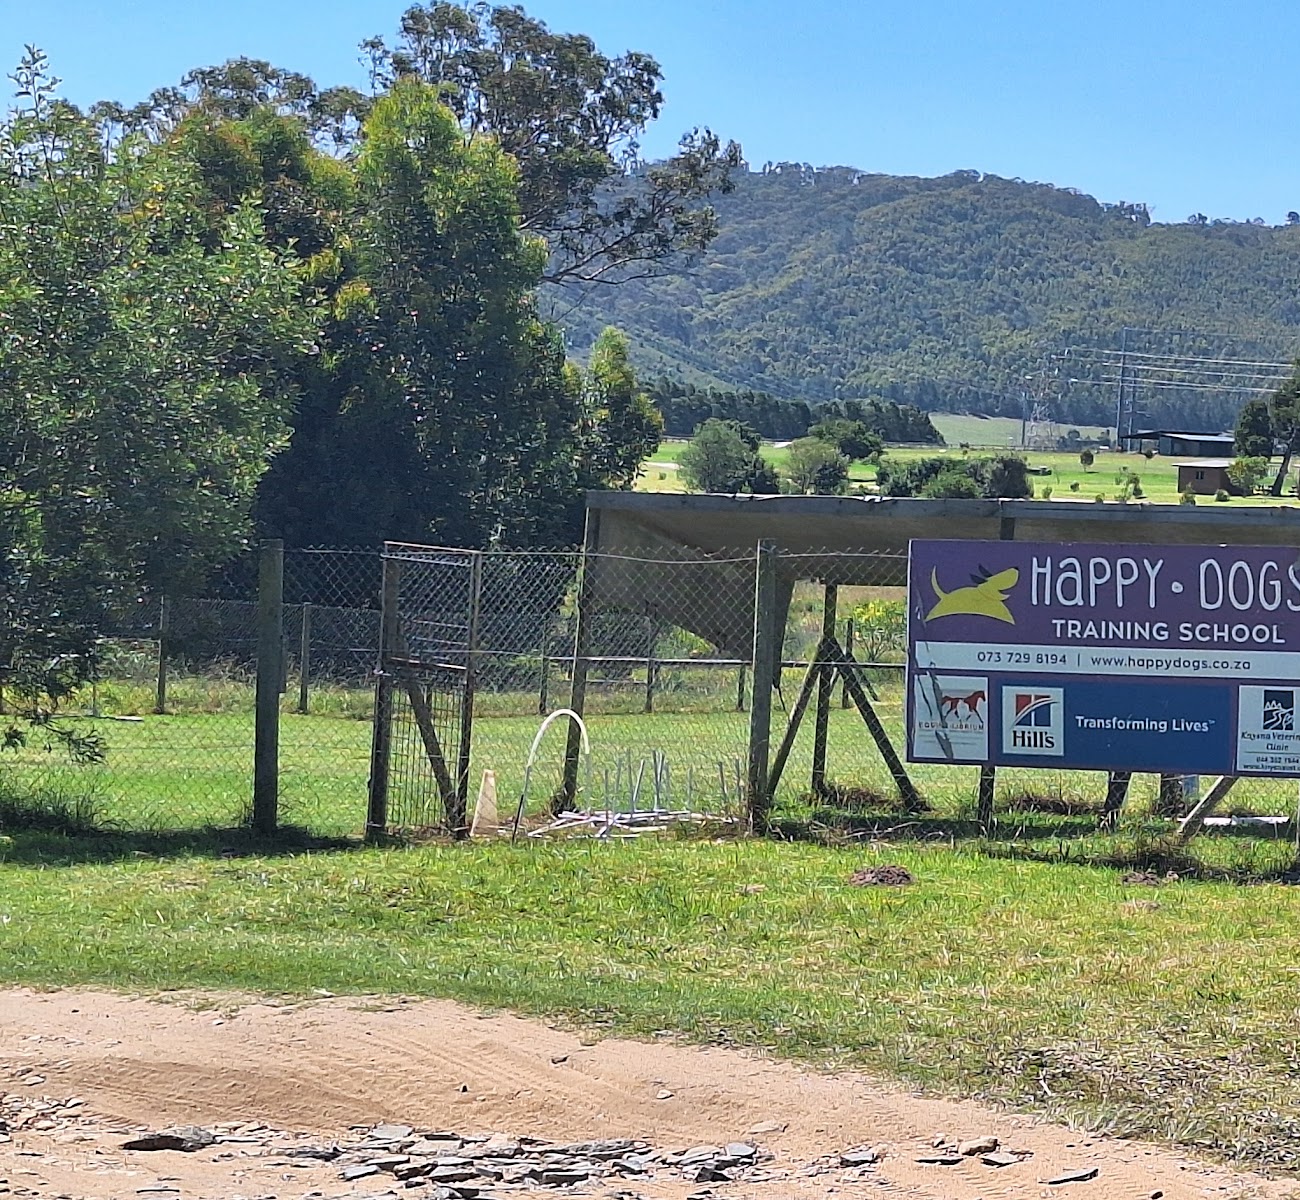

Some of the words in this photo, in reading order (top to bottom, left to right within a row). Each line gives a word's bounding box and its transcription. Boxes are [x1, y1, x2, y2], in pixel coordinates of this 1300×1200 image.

[1052, 619, 1170, 641] TRAINING
[1179, 622, 1286, 644] SCHOOL
[977, 651, 1002, 663] 073
[1006, 652, 1031, 664] 729
[1036, 653, 1067, 665] 8194
[1091, 655, 1251, 671] www.happydogs.co.za
[1075, 715, 1168, 733] Transforming
[1012, 730, 1055, 748] Hill's
[1266, 743, 1289, 751] Clinic
